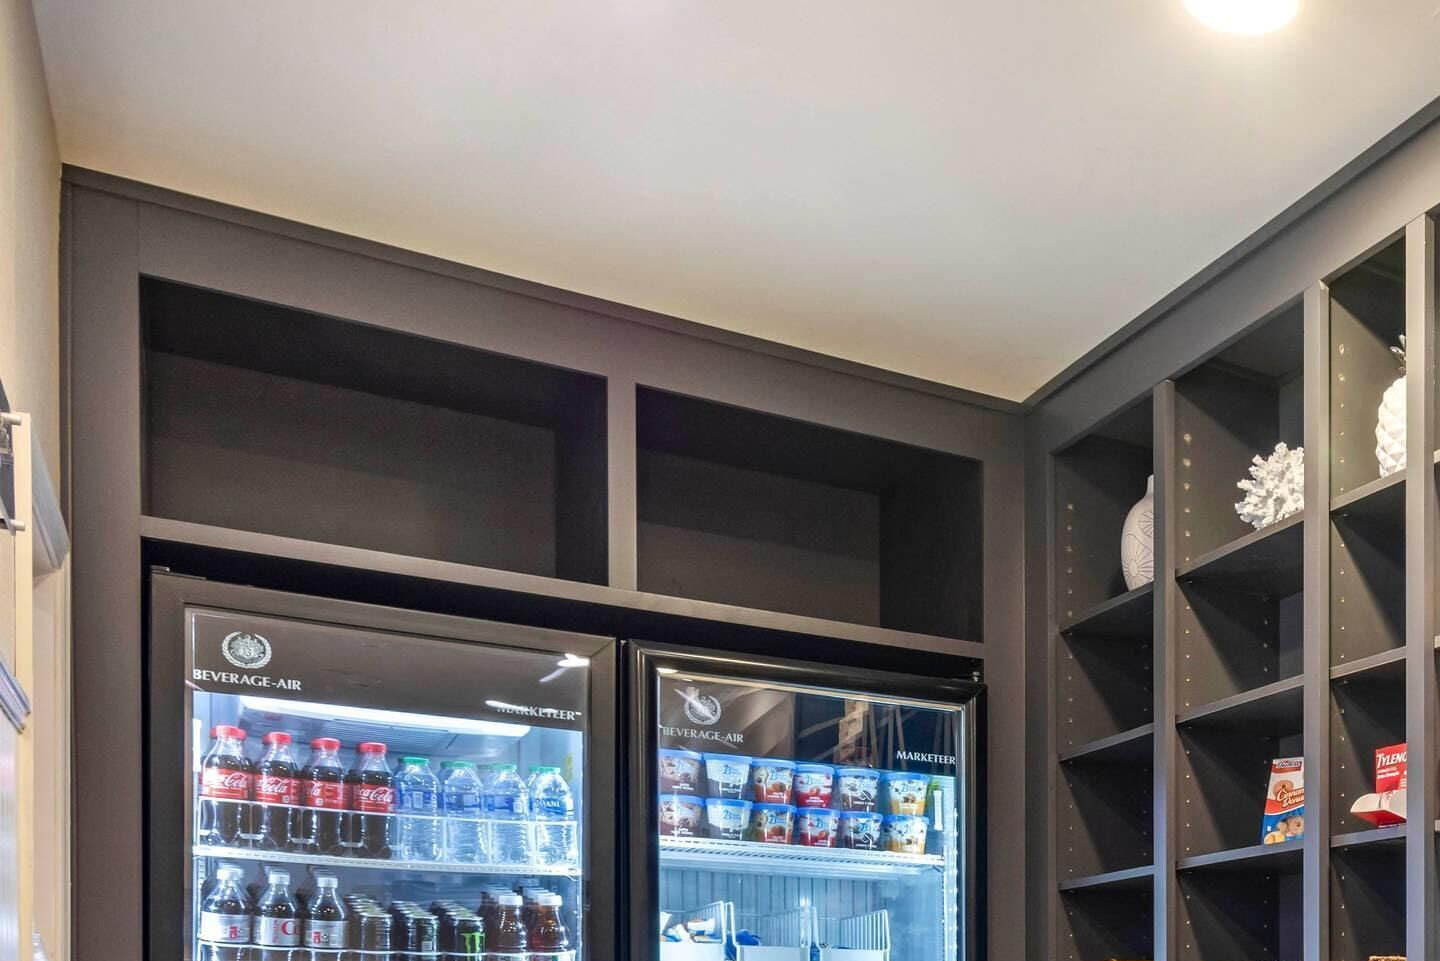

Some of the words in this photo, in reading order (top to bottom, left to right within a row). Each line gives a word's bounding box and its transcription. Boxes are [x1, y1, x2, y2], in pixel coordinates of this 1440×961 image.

[193, 668, 302, 691] BEVERAGE-AIR
[662, 727, 744, 743] BEVERAGE-AIR
[896, 750, 956, 765] MARKETEER
